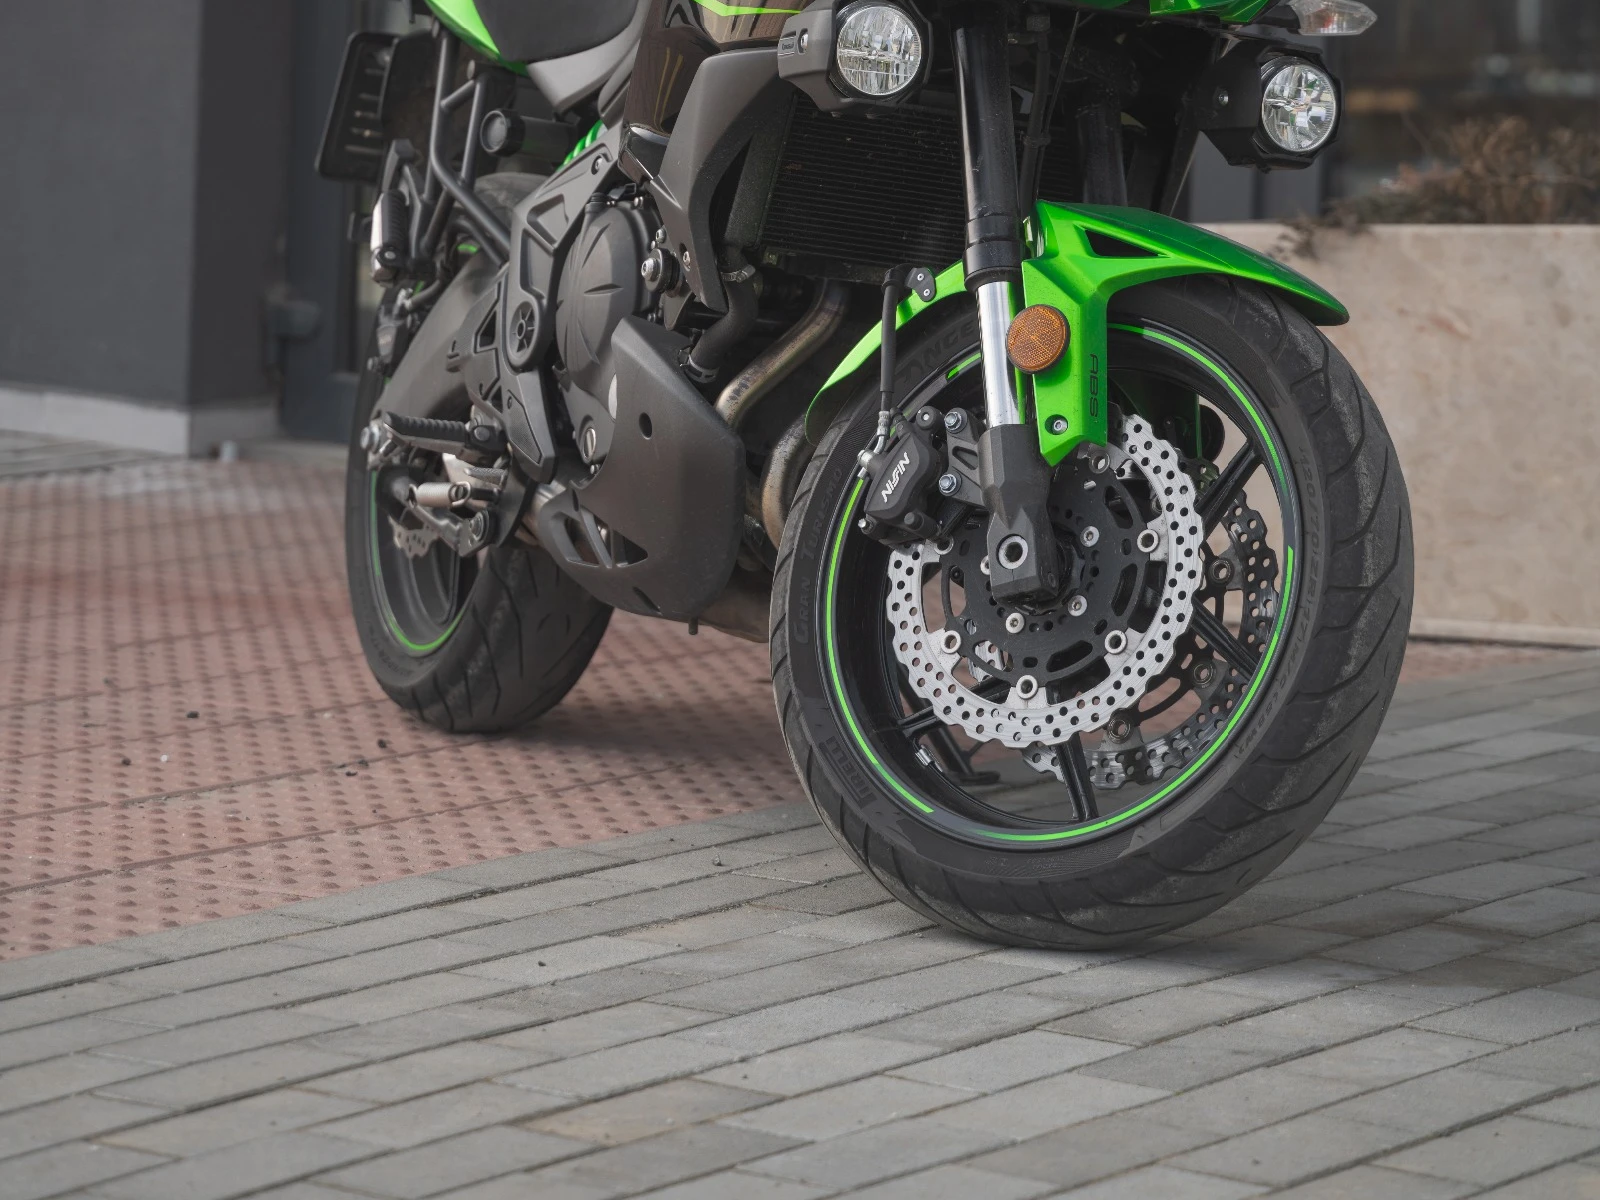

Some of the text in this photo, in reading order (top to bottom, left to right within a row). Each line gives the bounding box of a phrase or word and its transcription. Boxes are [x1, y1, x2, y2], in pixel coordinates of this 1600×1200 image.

[901, 320, 975, 384] ANGE
[1089, 353, 1099, 418] ABS
[819, 736, 878, 810] PIRELLI
